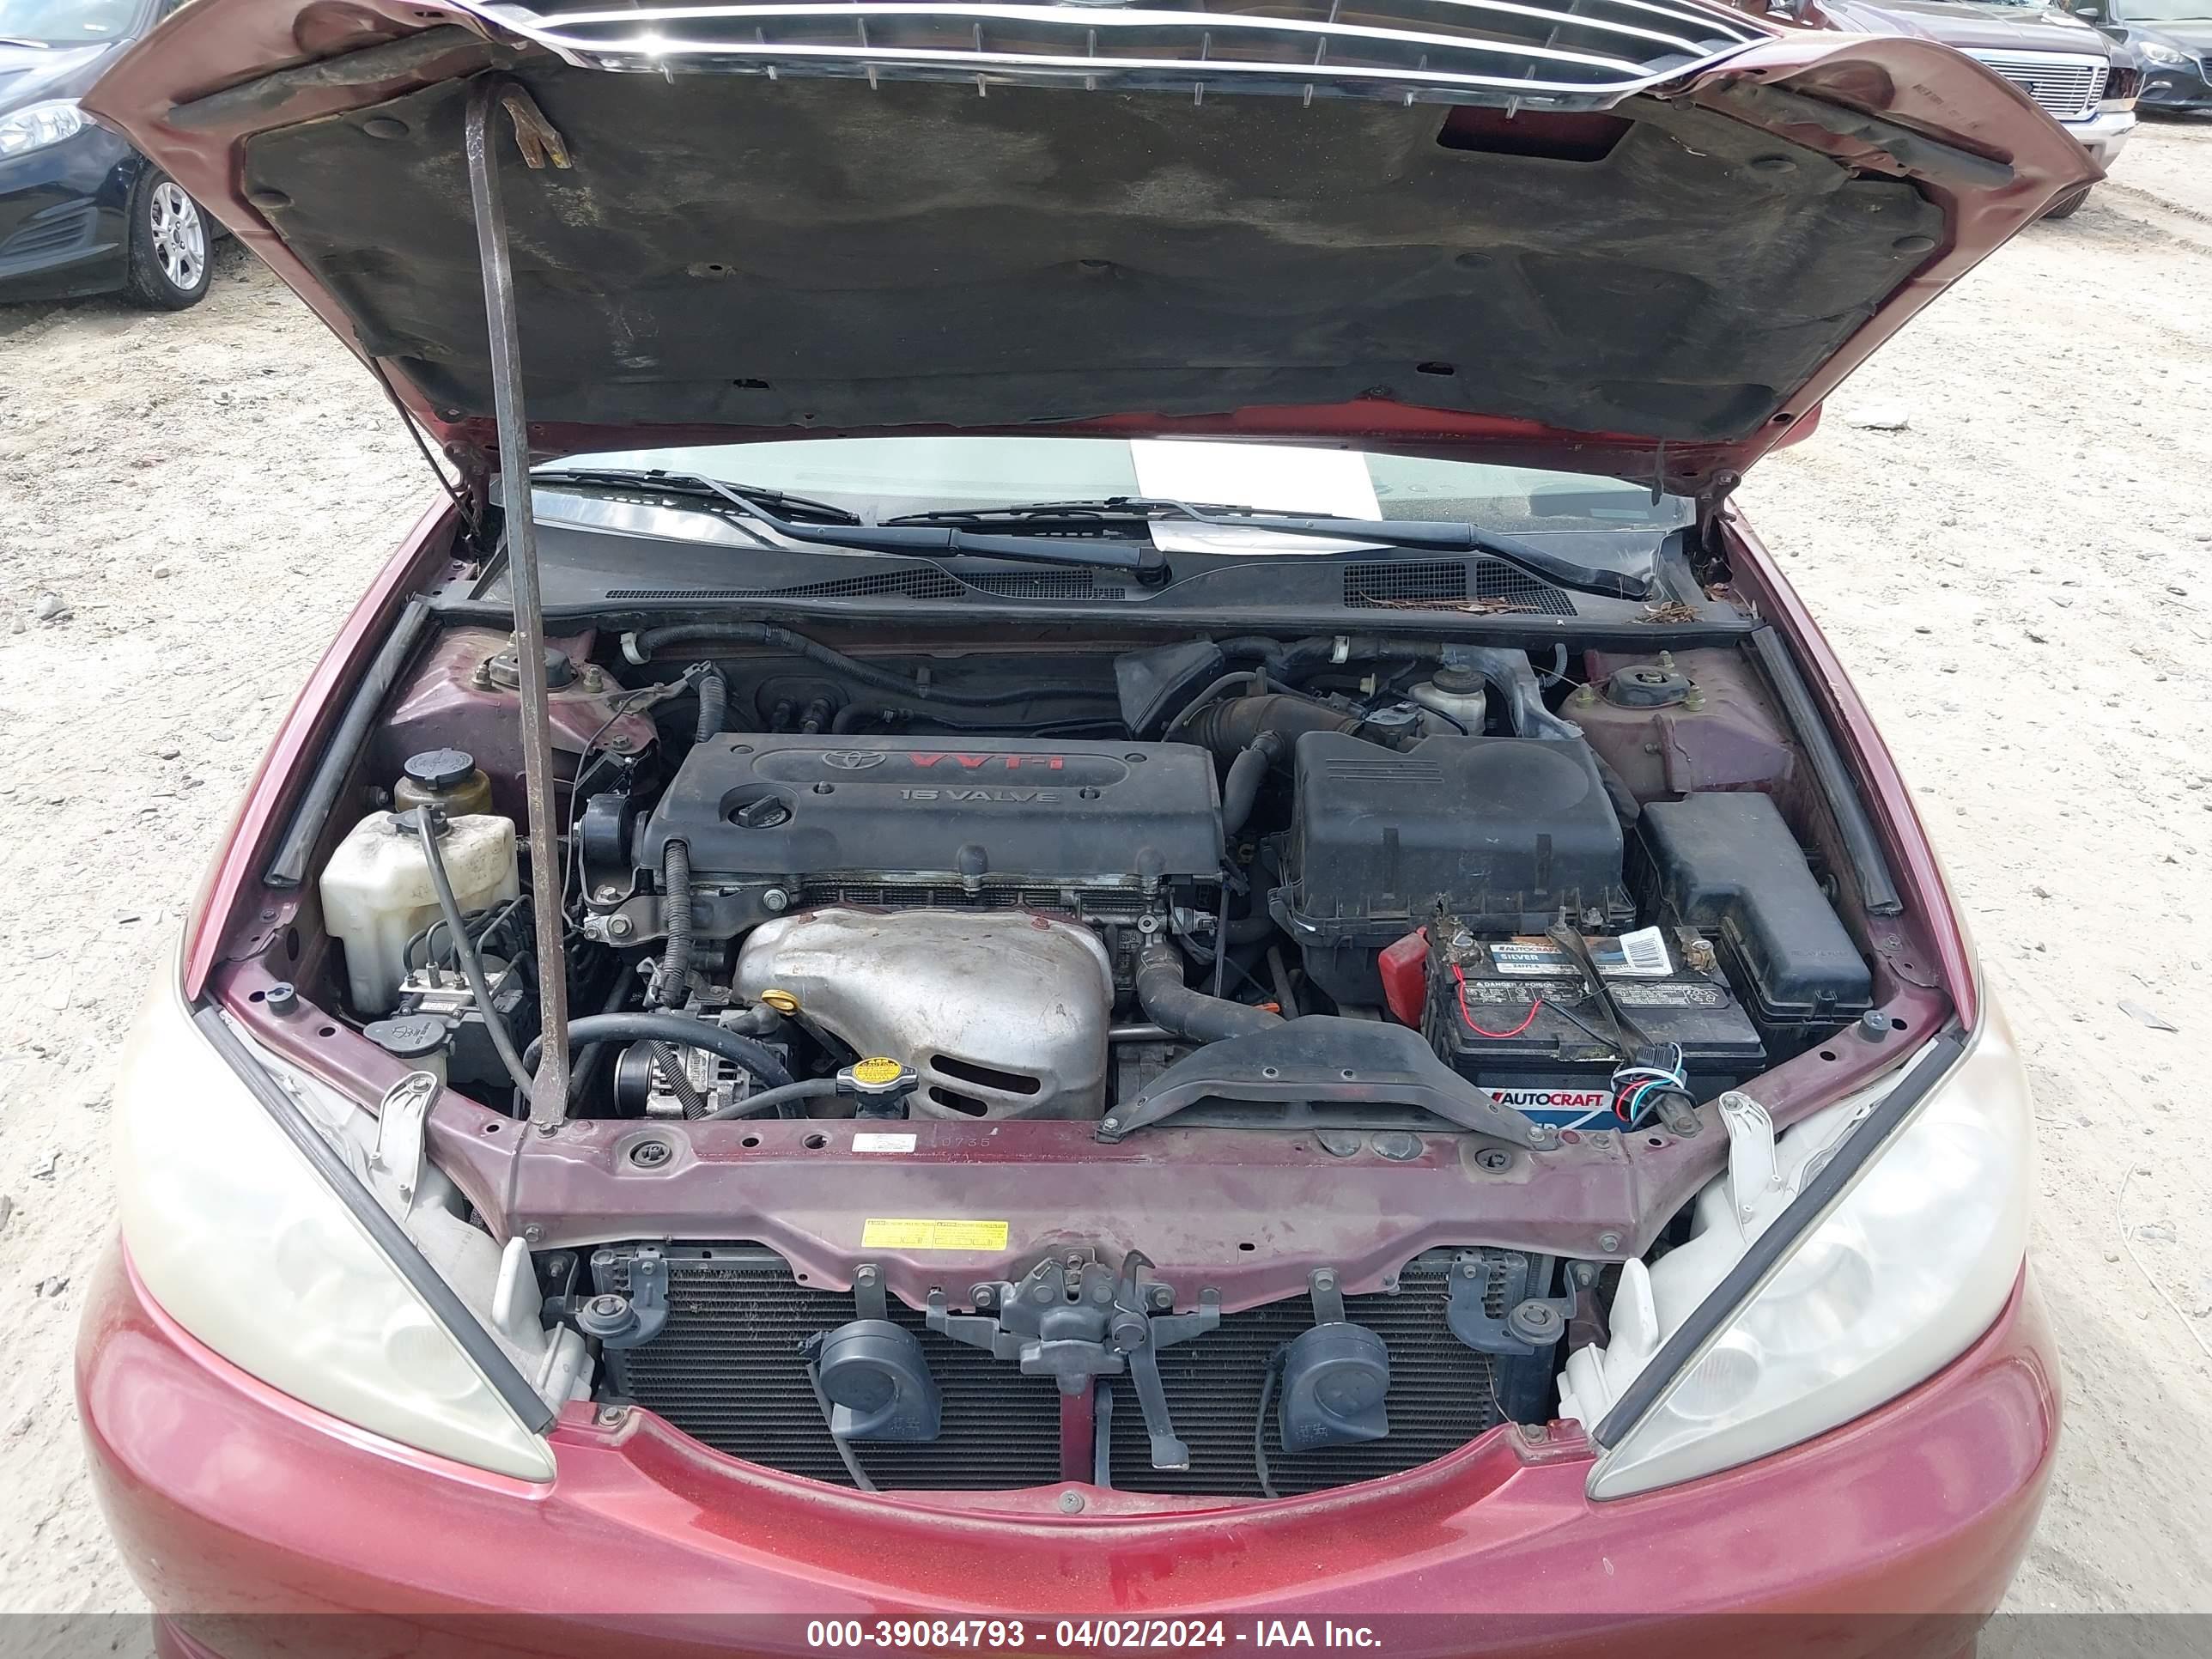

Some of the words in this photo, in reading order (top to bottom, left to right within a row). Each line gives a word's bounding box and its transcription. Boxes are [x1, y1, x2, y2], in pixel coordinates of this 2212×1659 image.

[900, 788, 941, 800] 16
[945, 789, 1060, 804] VALVE
[1501, 1091, 1603, 1107] AUTOCRAFT
